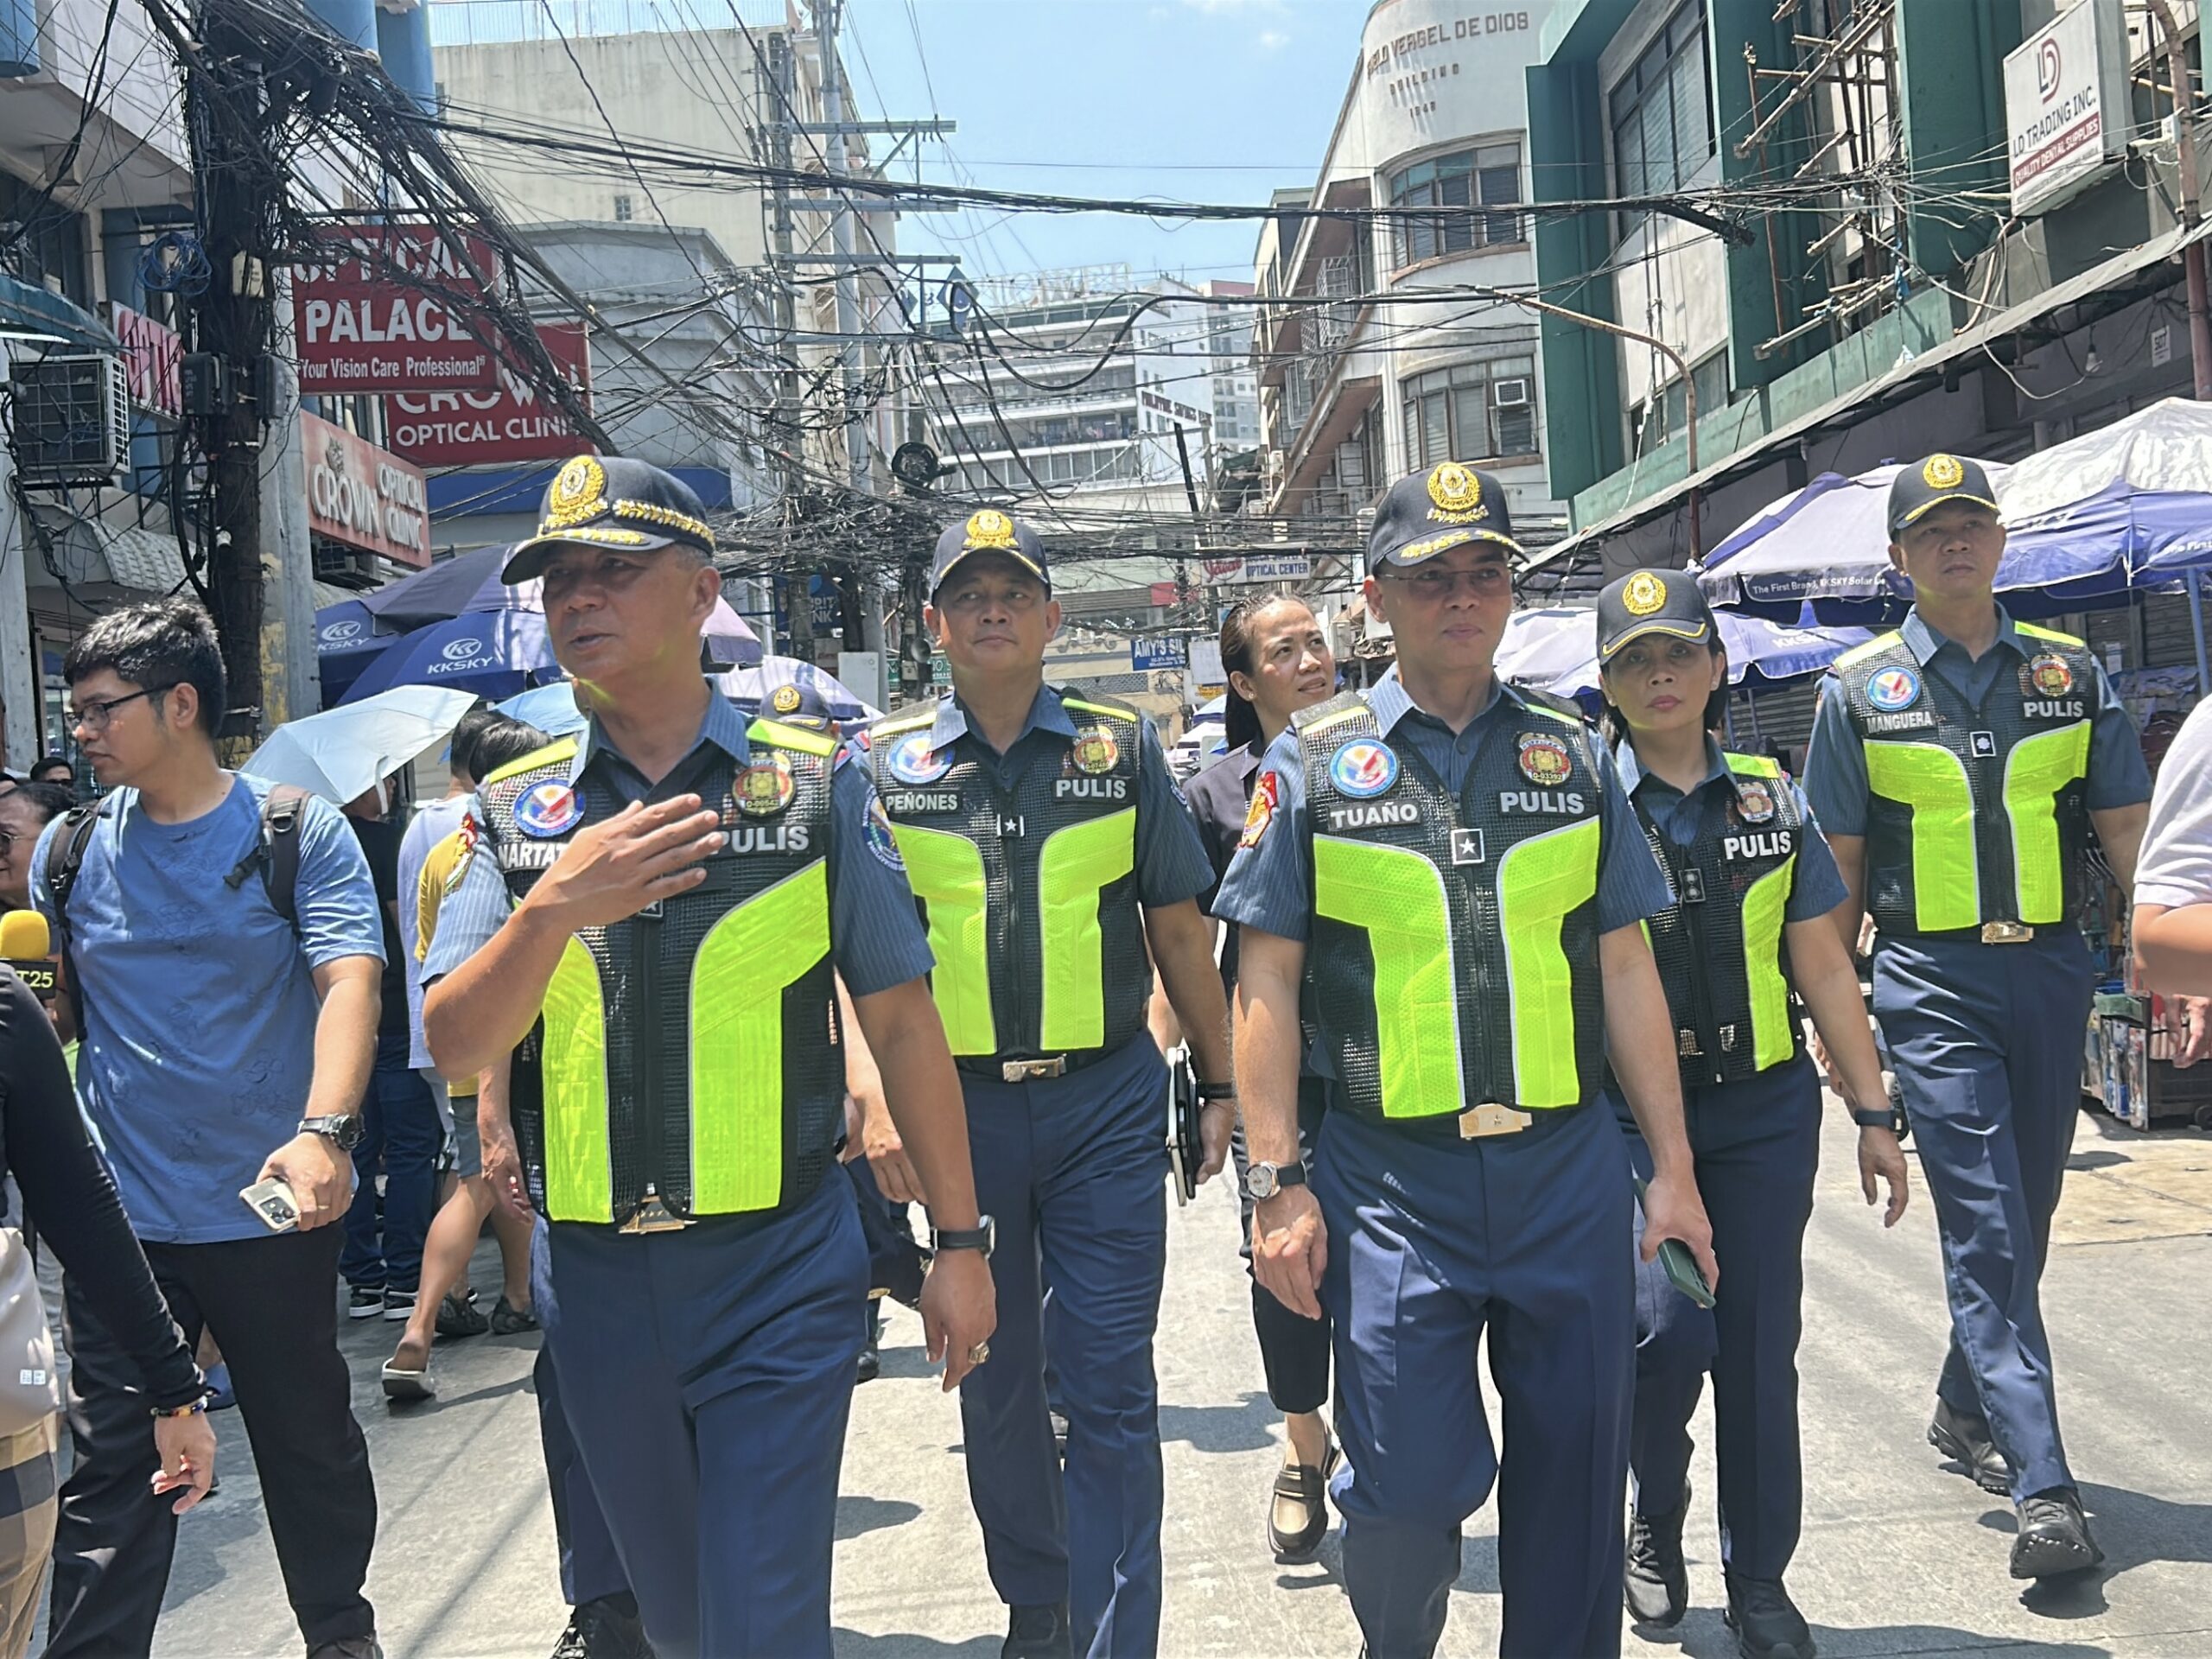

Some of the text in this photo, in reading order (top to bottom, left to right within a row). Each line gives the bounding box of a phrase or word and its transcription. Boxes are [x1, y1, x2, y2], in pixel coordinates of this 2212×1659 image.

[1391, 24, 1451, 58] VERGEL
[1455, 17, 1480, 40] DE
[1485, 11, 1529, 34] DIOS
[2013, 86, 2096, 158] LD TRADING INC.
[2015, 156, 2040, 187] QUALITY
[2040, 142, 2066, 167] DENTAL
[2065, 118, 2099, 151] SUPPLIES
[331, 358, 368, 378] Vision
[372, 357, 399, 378] Care
[396, 420, 501, 447] OPTICAL
[310, 463, 379, 539] CROWN
[376, 462, 427, 514] OPTICAL
[385, 506, 424, 553] CLINIC
[1246, 564, 1277, 576] OPTICAL
[1279, 563, 1307, 575] CENTER
[1753, 586, 1769, 594] The
[1770, 583, 1790, 593] First
[1848, 576, 1872, 586] Solar
[1135, 639, 1185, 658] AMY'S SIL
[428, 657, 493, 674] KKSKY
[1866, 701, 2083, 733] MANGUERA PULIS
[887, 791, 957, 810] PEÑONES
[1056, 779, 1126, 799] PULIS
[1331, 802, 1418, 828] TUAÑO
[1501, 791, 1585, 814] PULIS
[1724, 831, 1791, 860] PULIS
